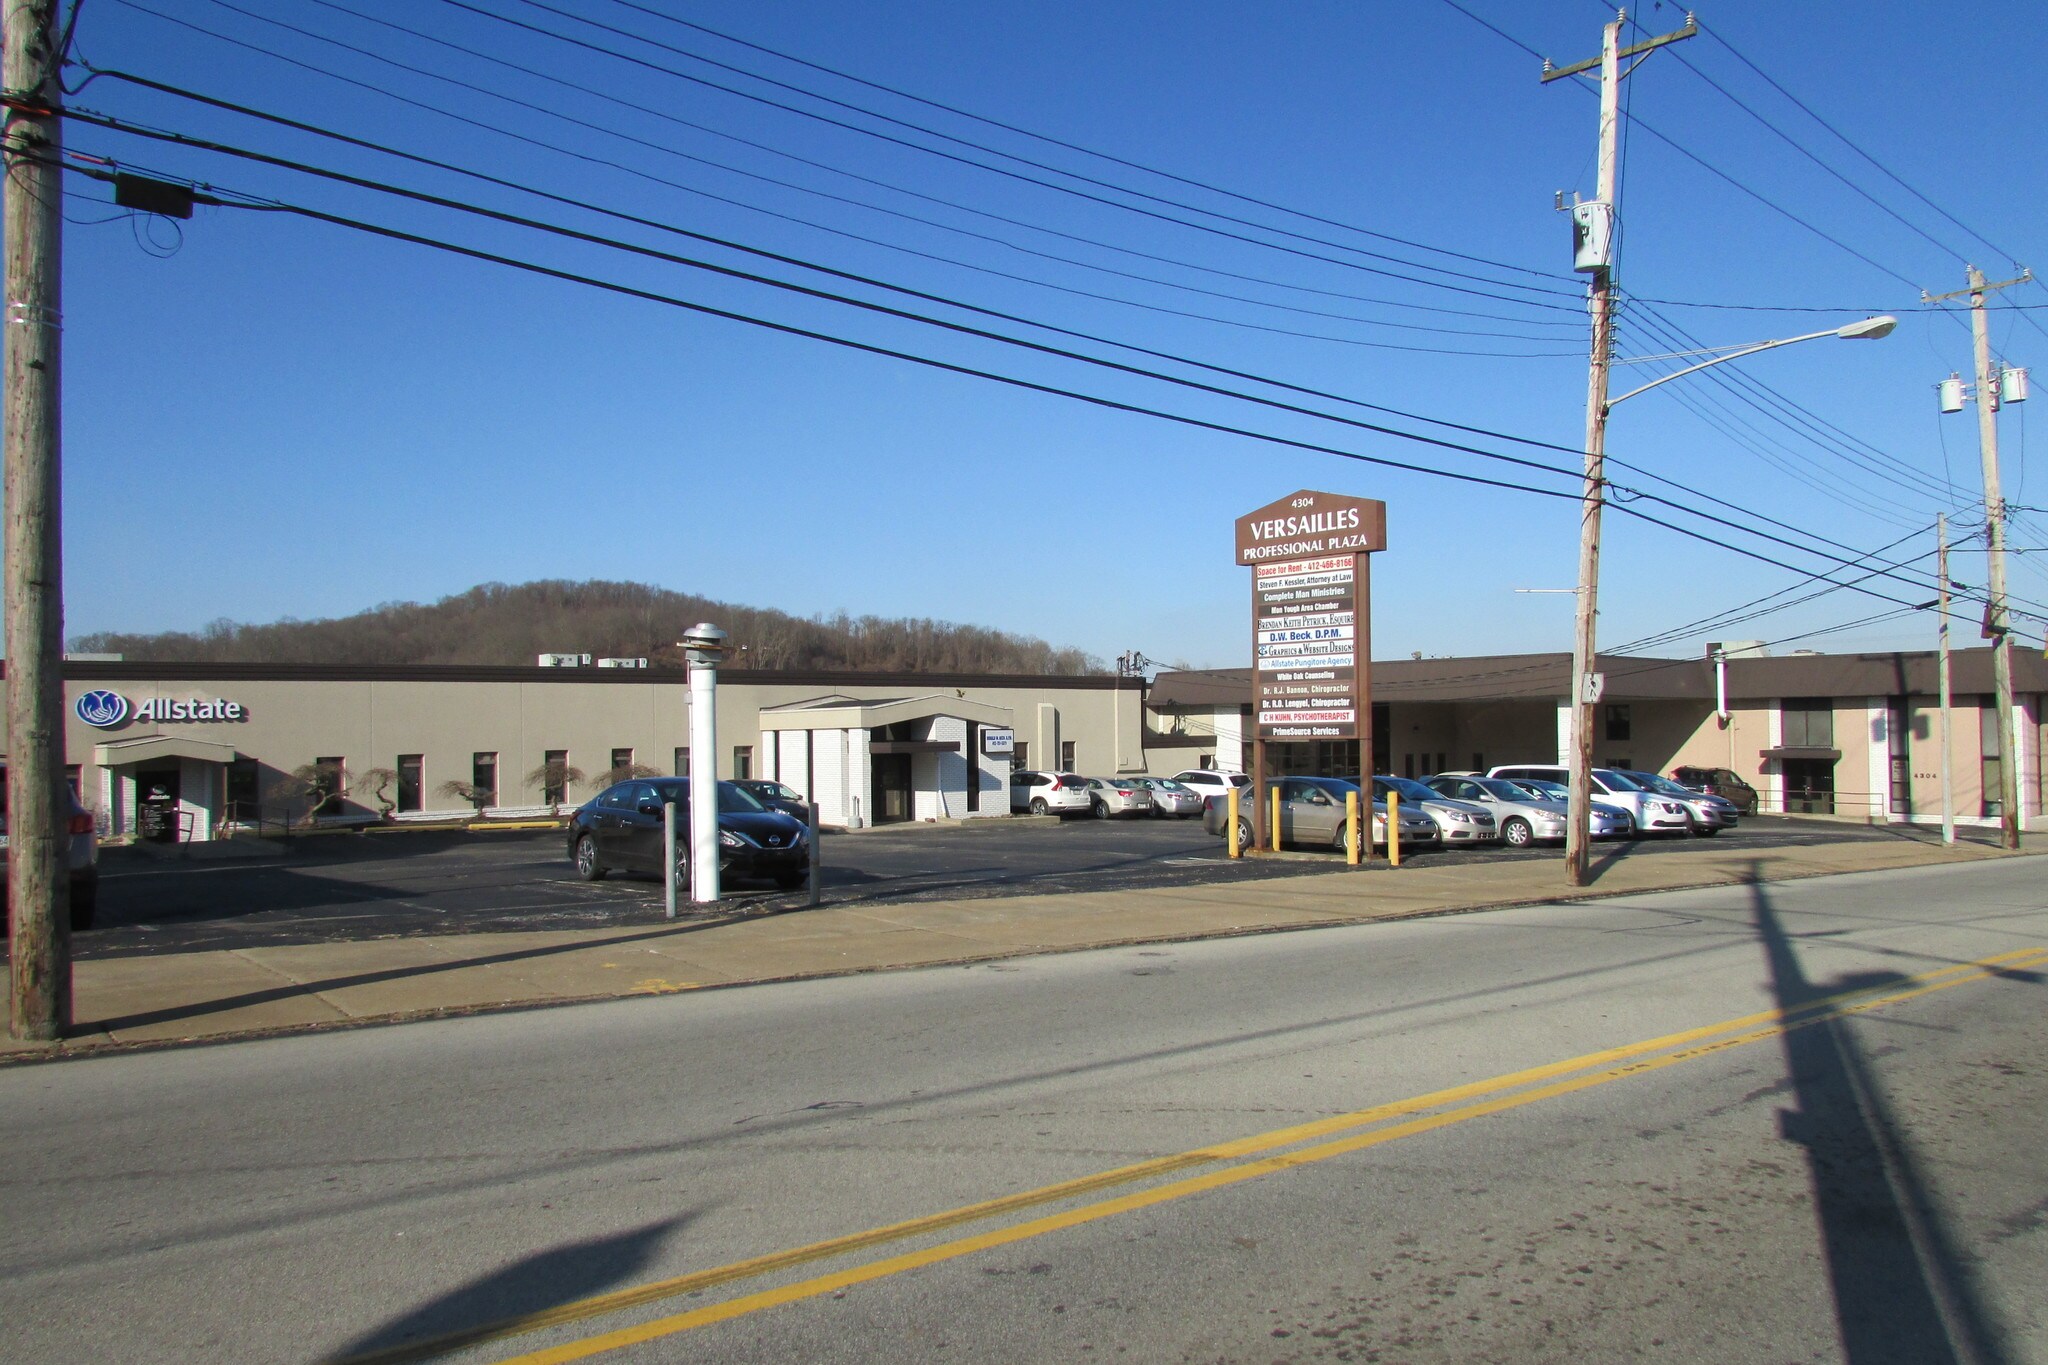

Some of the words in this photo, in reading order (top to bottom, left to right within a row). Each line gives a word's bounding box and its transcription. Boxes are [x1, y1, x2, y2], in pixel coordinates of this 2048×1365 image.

[1292, 497, 1313, 508] 4304
[1250, 508, 1359, 540] VERSAILLES
[1243, 540, 1324, 560] PROFESSIONAL
[1328, 534, 1367, 549] PLAZA
[1258, 566, 1276, 576] Space
[1278, 566, 1286, 574] for
[1288, 564, 1302, 573] Rent
[1259, 580, 1277, 589] Steven
[1285, 577, 1306, 587] Kessler,
[1307, 575, 1330, 584] Attorney
[1340, 573, 1352, 581] Law
[1264, 592, 1294, 602] Complete
[1295, 590, 1310, 599] Man
[1311, 587, 1345, 597] Ministries
[1271, 606, 1283, 614] Mon
[1284, 605, 1300, 613] Yough
[1315, 602, 1339, 611] Chamber
[1270, 632, 1288, 642] D.W.
[1315, 629, 1342, 639] D.P.M.
[1268, 645, 1297, 656] GRAPHICS
[1303, 643, 1328, 654] WEBSITE
[1271, 659, 1294, 668] Allstate
[1295, 657, 1327, 668] Pungitore
[1327, 657, 1352, 667] Agency
[1305, 671, 1335, 680] Counseling
[1263, 687, 1272, 695] Dr.
[1311, 684, 1349, 693] Chiropractor
[133, 697, 241, 720] Allstate
[1262, 700, 1271, 709] Dr.
[1311, 698, 1350, 707] Chiropractor
[1270, 713, 1274, 721] H
[1294, 712, 1350, 721] PSYCHOTHERAPIST
[1272, 727, 1311, 736] PrimeSource
[1312, 726, 1339, 735] Services
